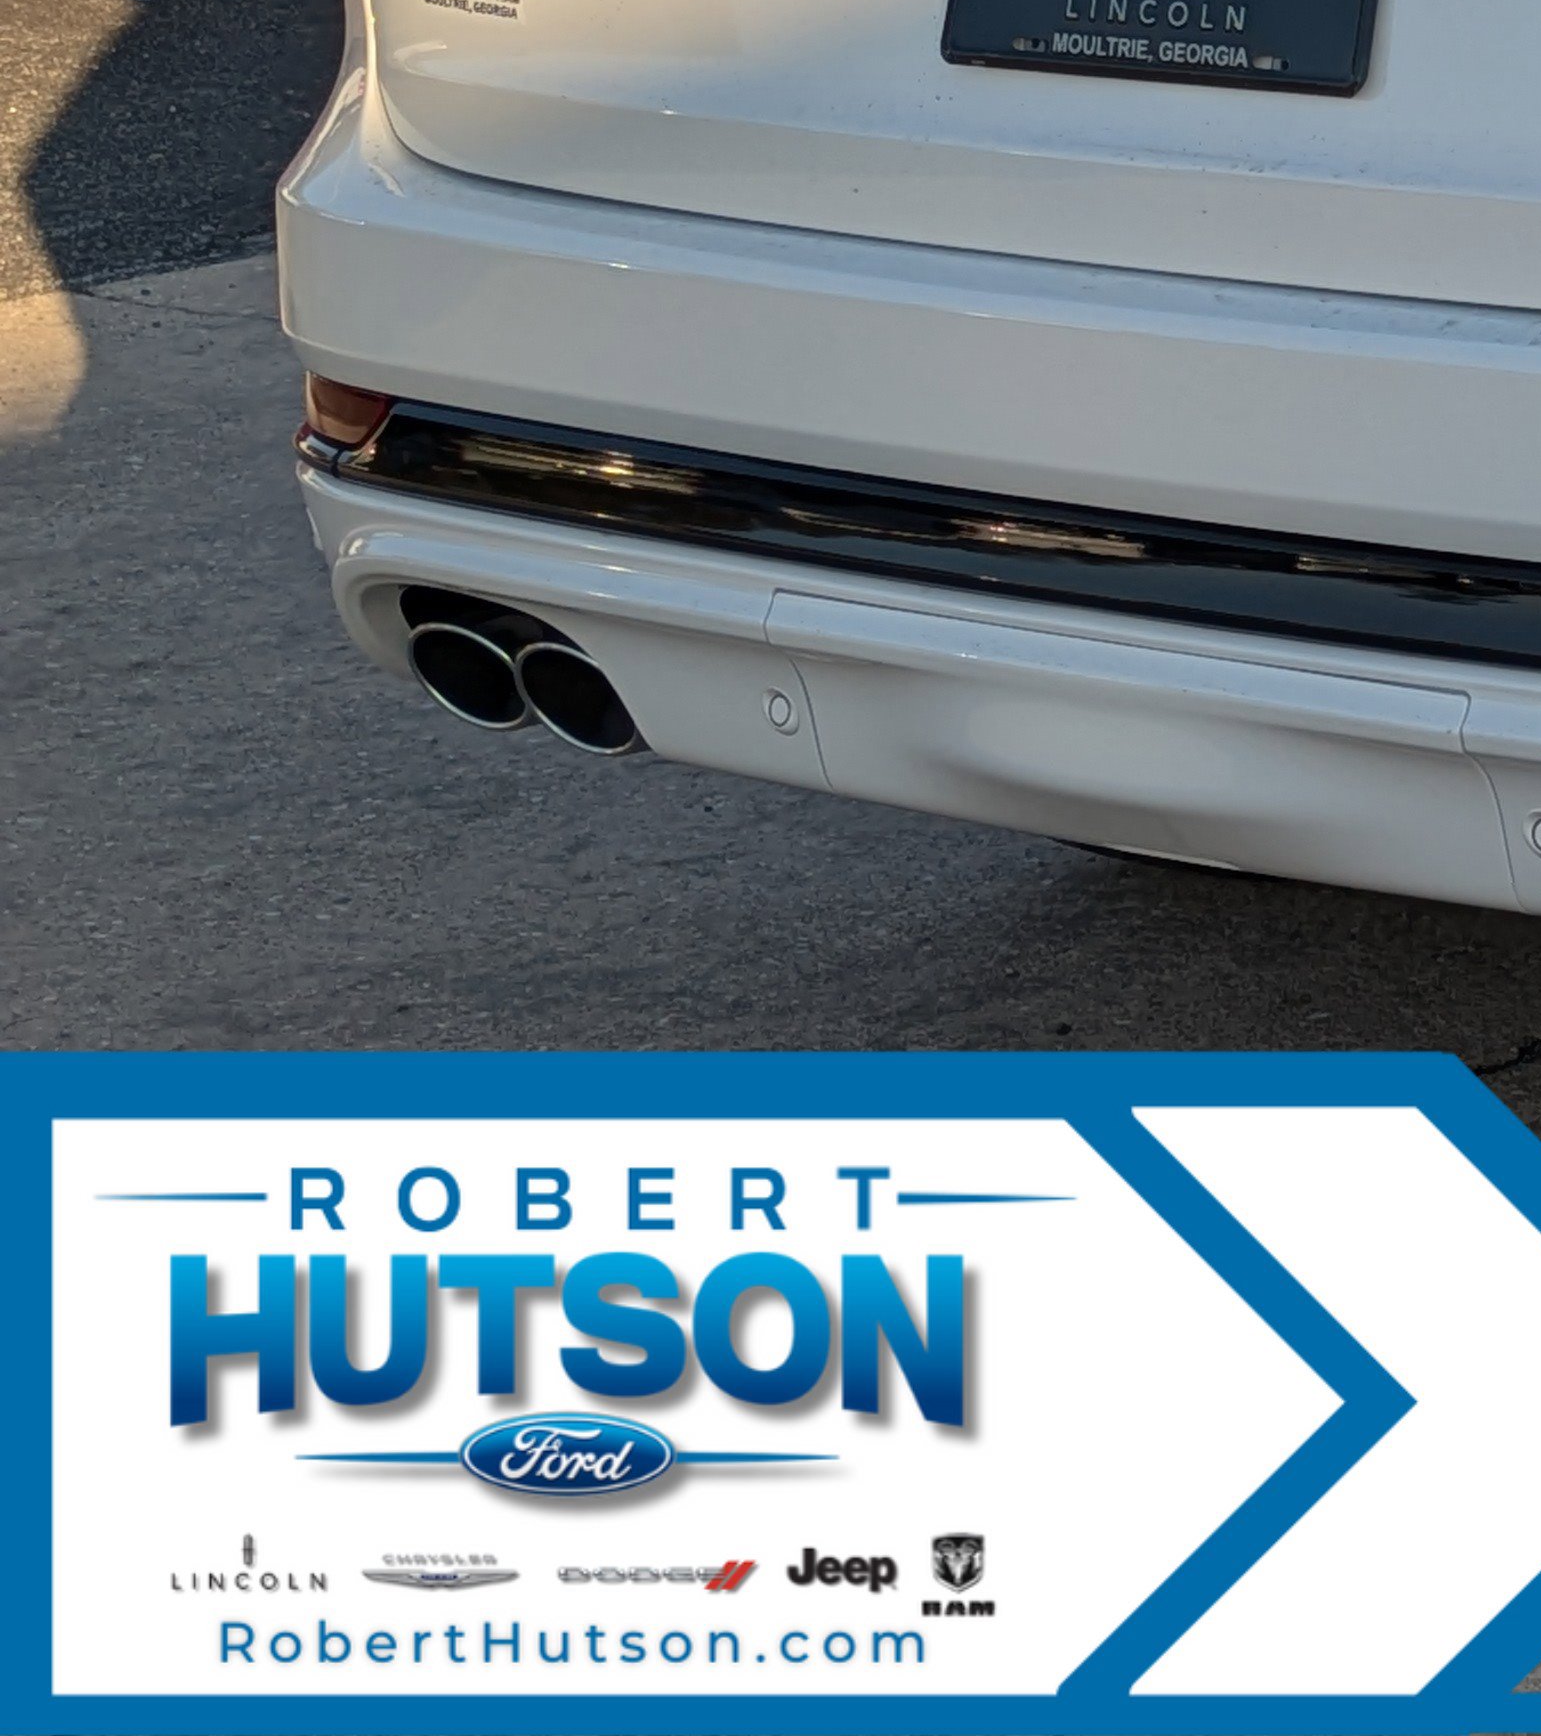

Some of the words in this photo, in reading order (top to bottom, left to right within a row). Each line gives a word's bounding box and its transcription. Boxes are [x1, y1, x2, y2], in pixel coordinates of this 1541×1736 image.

[473, 2, 518, 20] GEORGIA
[1052, 32, 1153, 64] MOULTRIE,
[1158, 40, 1248, 69] GEORGIA
